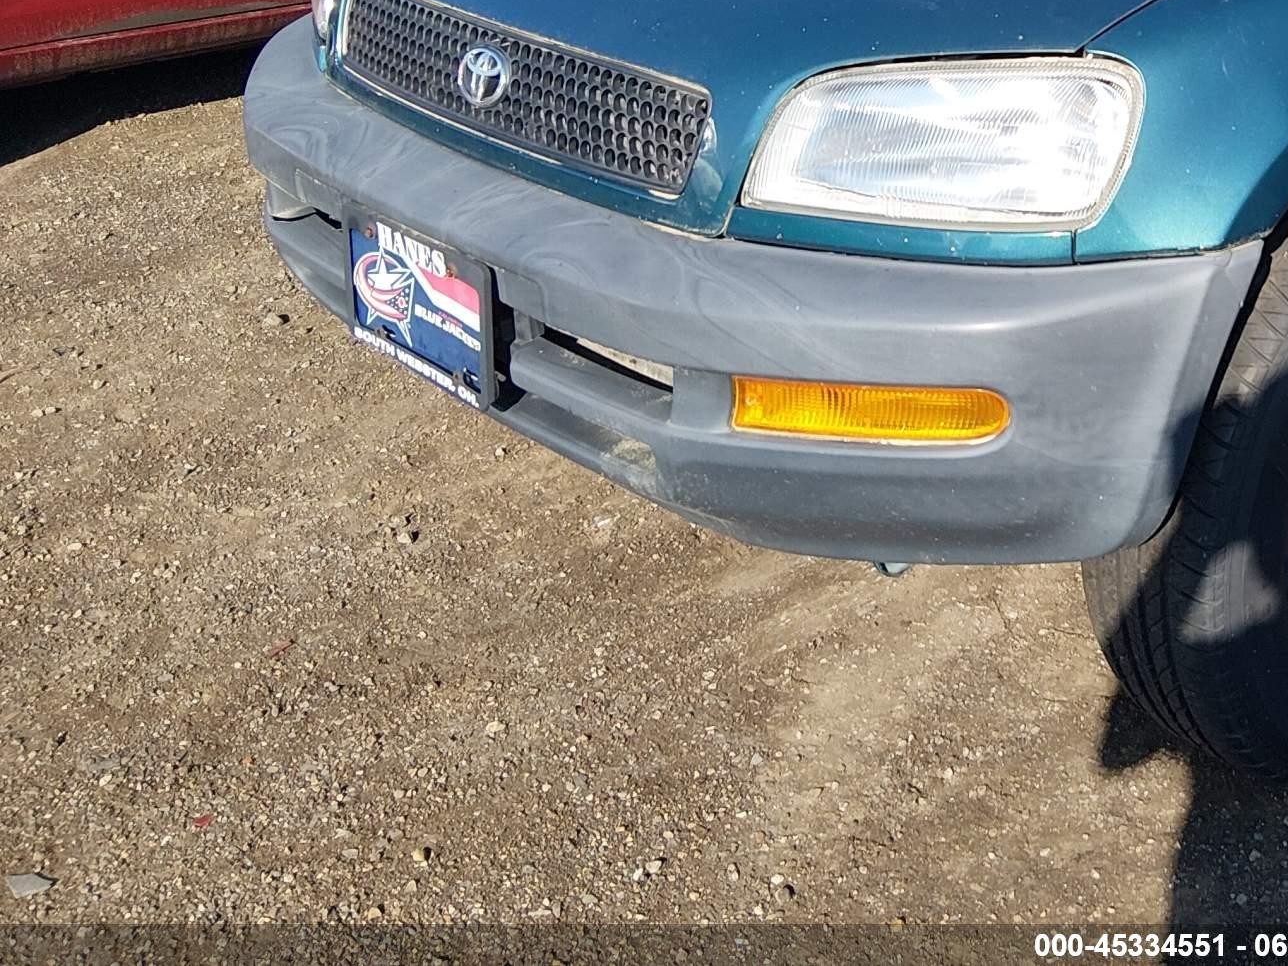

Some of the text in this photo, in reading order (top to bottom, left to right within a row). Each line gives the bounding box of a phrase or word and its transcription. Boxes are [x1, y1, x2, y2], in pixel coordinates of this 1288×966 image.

[375, 221, 448, 278] HANES
[414, 303, 444, 329] BLUE
[353, 326, 396, 357] SOUTH
